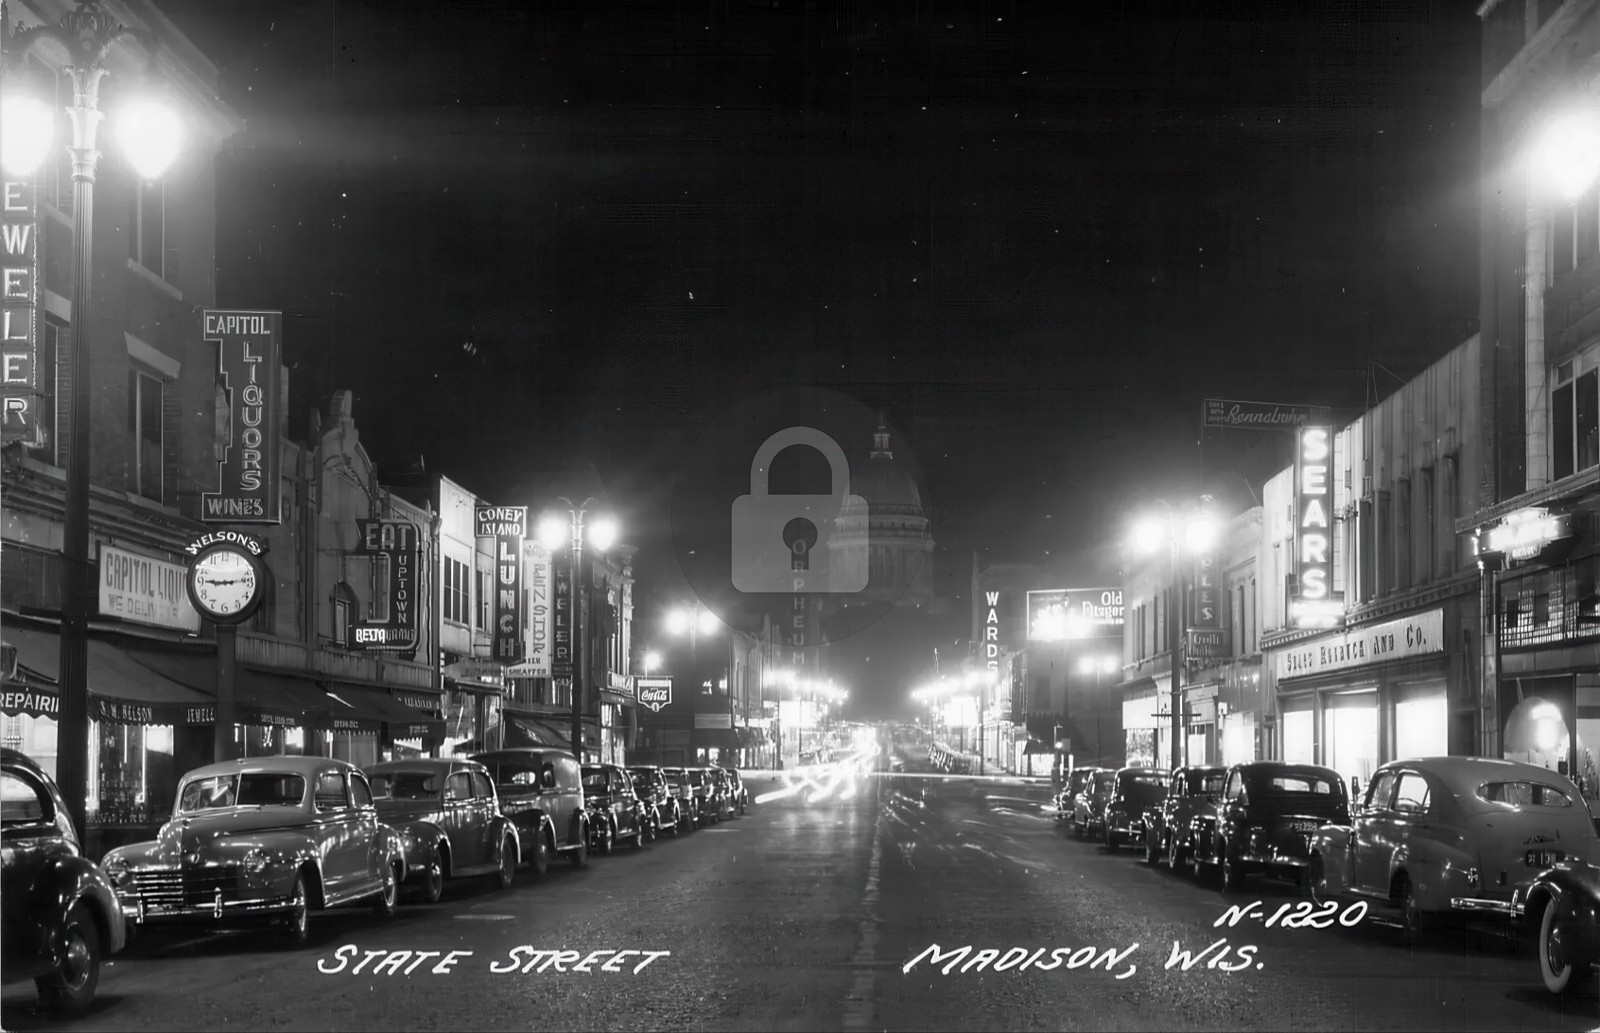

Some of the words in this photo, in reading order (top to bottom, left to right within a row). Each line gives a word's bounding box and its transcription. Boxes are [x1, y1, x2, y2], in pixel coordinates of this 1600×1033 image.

[3, 183, 31, 426] EWELER
[206, 315, 270, 335] CAPITOL
[240, 341, 263, 491] LIQUORS
[207, 498, 264, 516] WINES
[479, 508, 523, 522] CONEY
[1302, 429, 1328, 599] SEARS
[185, 531, 261, 555] NELSON'S
[365, 523, 411, 550] EAT
[482, 523, 520, 536] ISLAND
[106, 552, 154, 597] CAPITOL
[396, 555, 408, 624] UPTOWN
[500, 542, 515, 657] LUNCH
[556, 570, 569, 659] EWELER
[792, 539, 806, 665] ORPHEUM
[1101, 591, 1123, 606] Old
[356, 628, 415, 644] RESTAURANT
